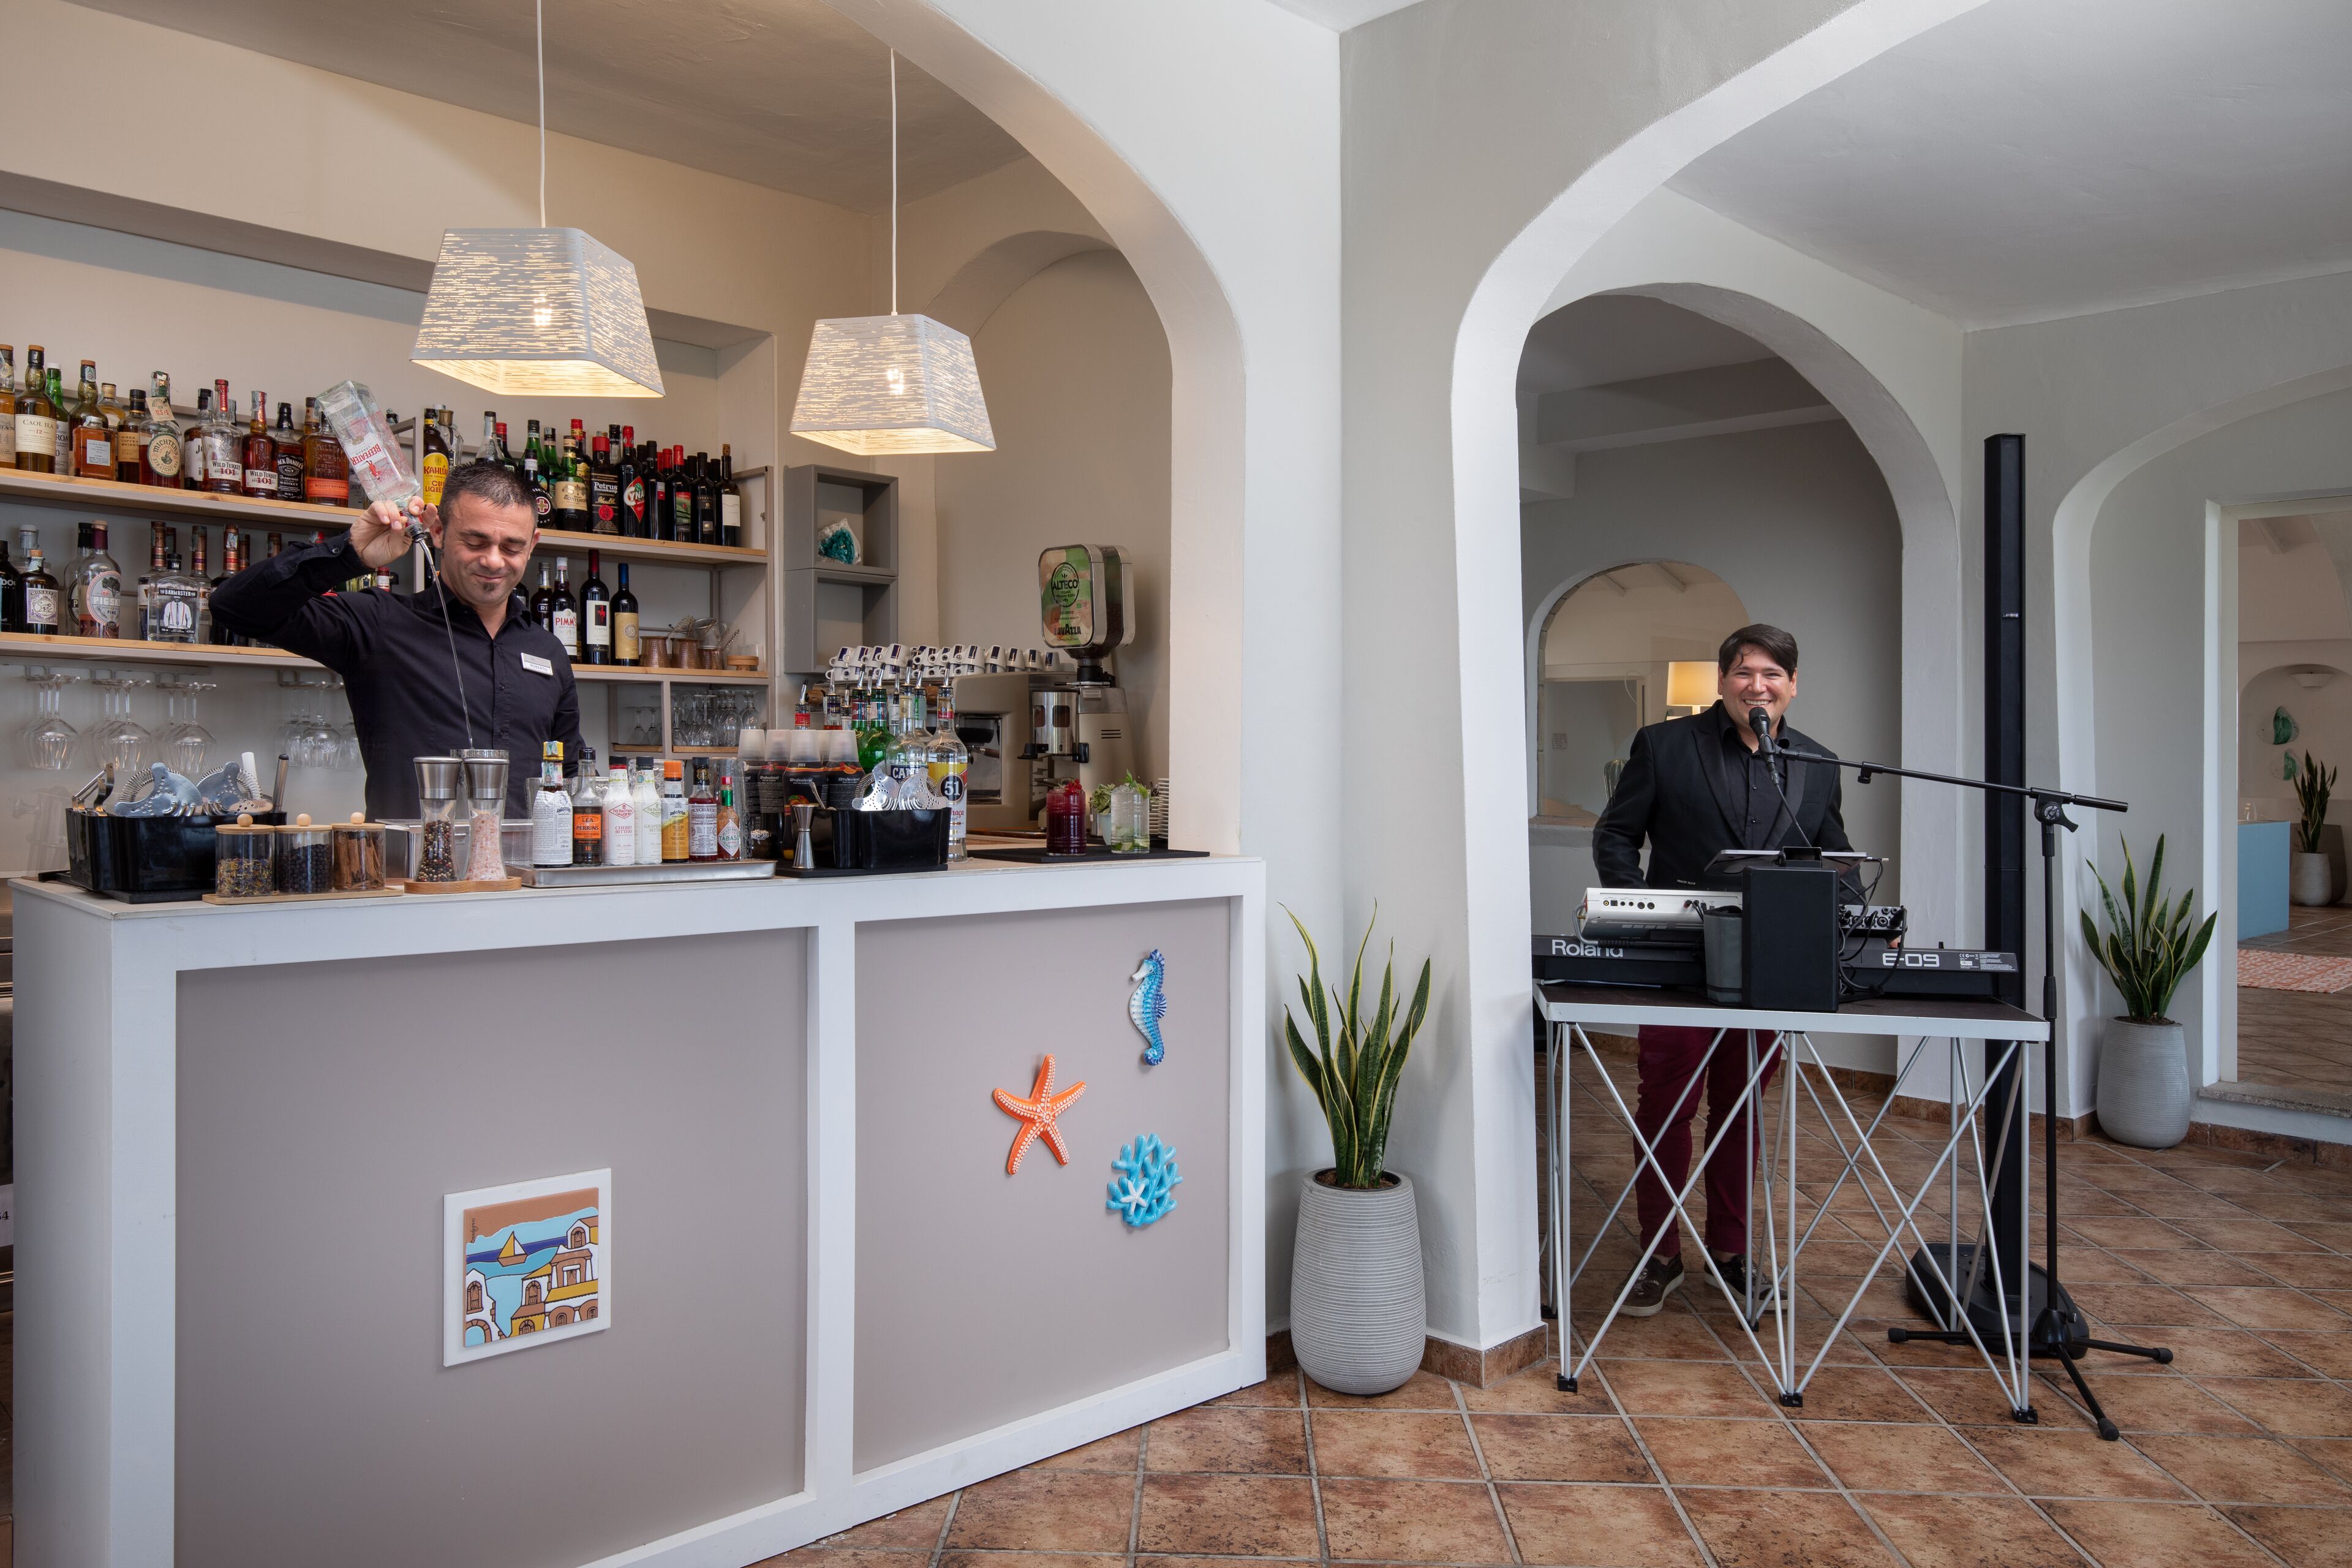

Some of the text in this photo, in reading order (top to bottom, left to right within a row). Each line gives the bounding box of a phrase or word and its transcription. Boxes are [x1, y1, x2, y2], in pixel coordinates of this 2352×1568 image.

[350, 443, 382, 466] BEEFEATER
[286, 458, 304, 470] DANIEL'S
[594, 481, 617, 490] Petrus
[1053, 579, 1078, 590] ALTECO
[1054, 624, 1082, 635] LAVAZZA
[530, 663, 548, 672] ROBERTO
[944, 781, 960, 796] 51
[1882, 952, 1940, 968] E-09
